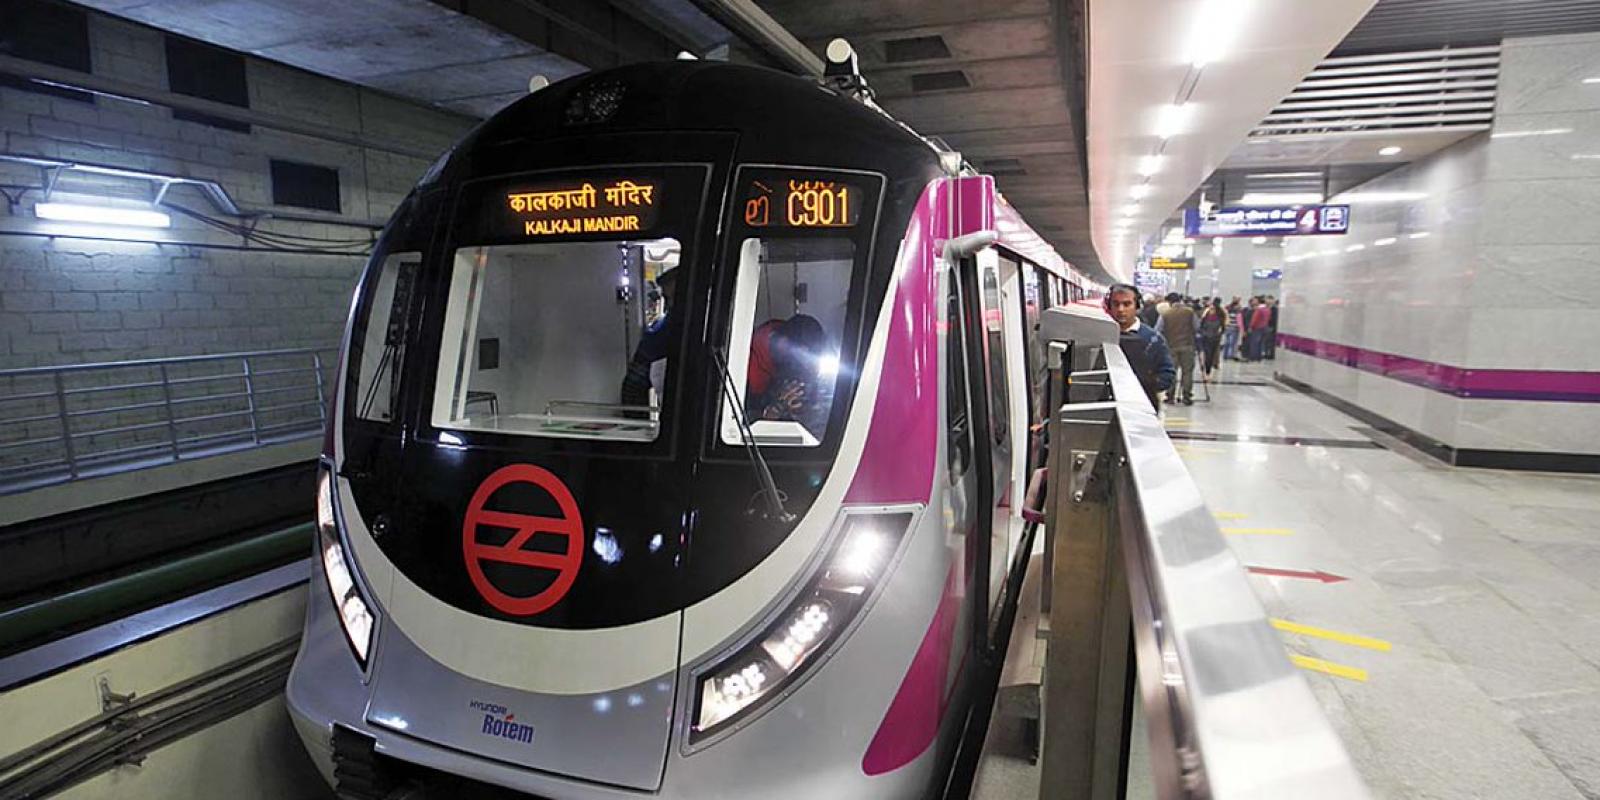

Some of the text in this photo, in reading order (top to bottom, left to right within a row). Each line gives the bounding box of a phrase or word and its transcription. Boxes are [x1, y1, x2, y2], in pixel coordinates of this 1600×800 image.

[508, 180, 653, 212] कालकाजी मंदिर
[787, 188, 848, 226] C901
[525, 215, 640, 236] KALKAJI MANDIR
[1300, 210, 1317, 228] 4
[470, 699, 508, 714] HYUNDAI
[482, 714, 534, 743] Rotem
